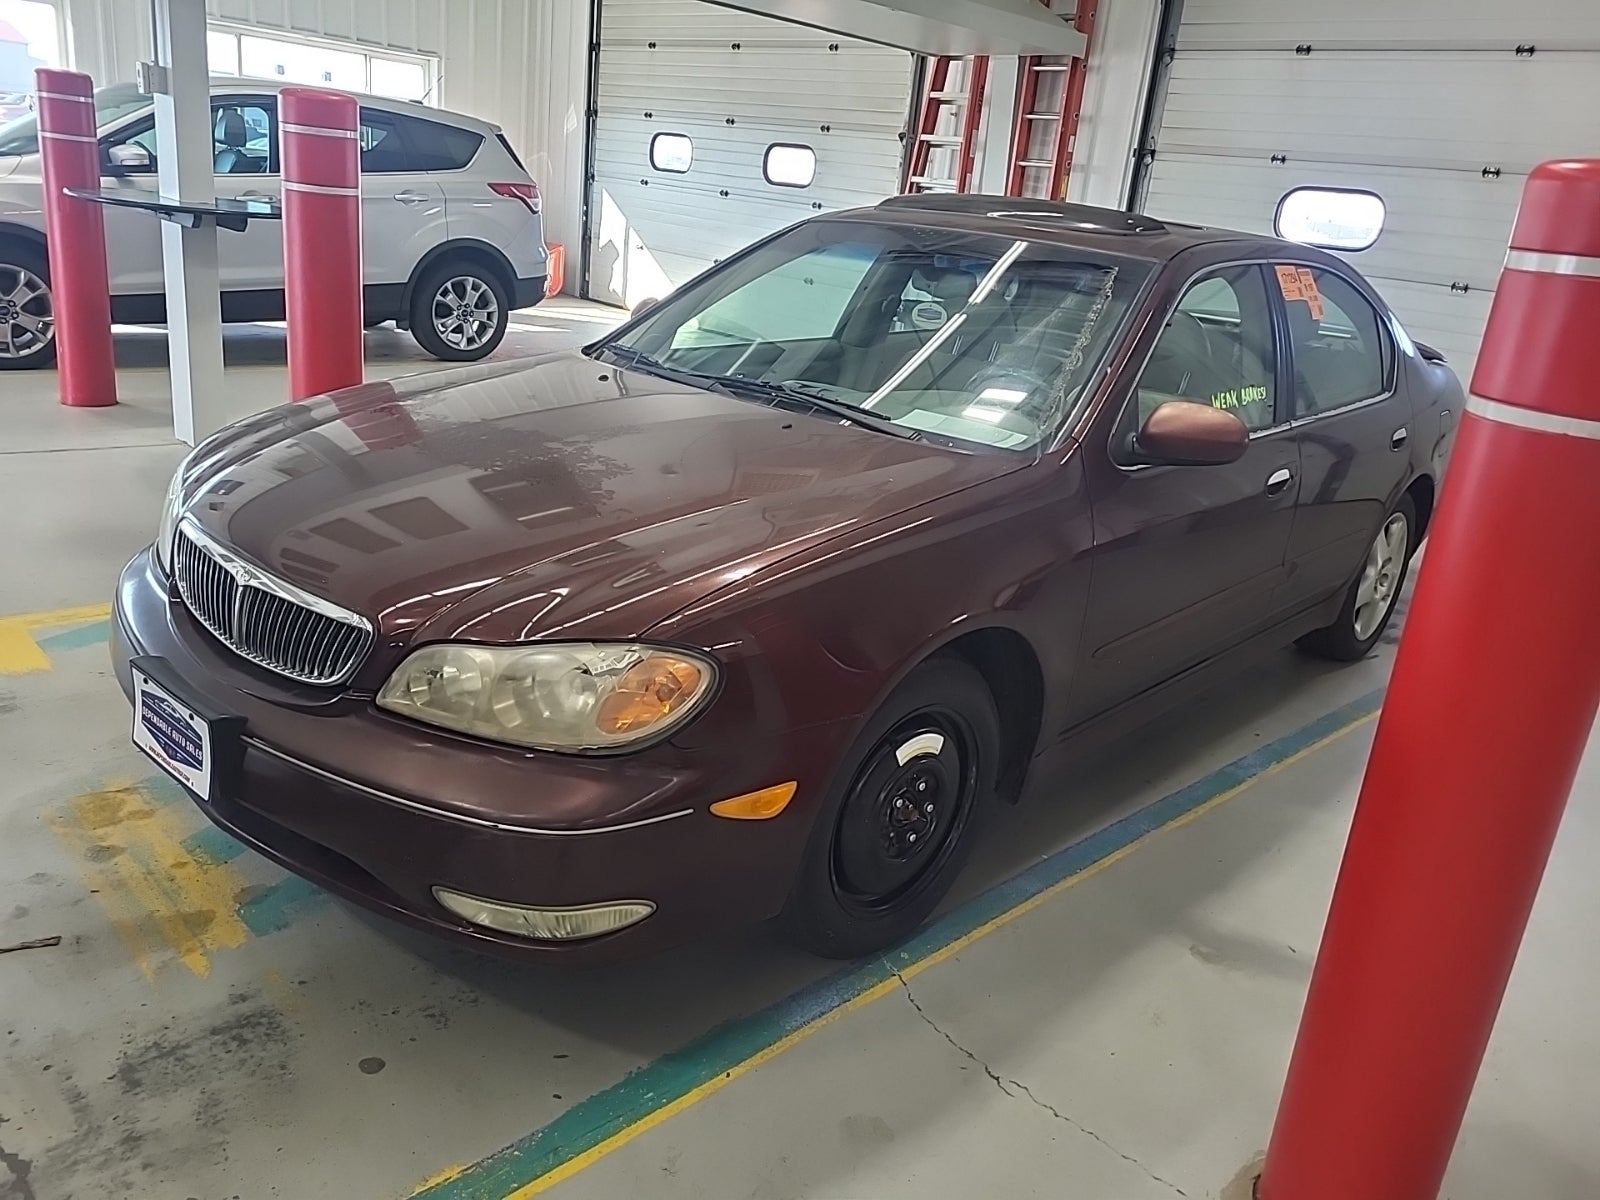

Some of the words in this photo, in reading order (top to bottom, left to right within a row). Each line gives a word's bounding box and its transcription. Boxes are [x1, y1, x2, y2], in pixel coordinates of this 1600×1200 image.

[1211, 390, 1239, 409] WEAK
[142, 705, 171, 734] DEPENDABLE
[172, 729, 186, 747] AUTO
[186, 740, 203, 761] SALES
